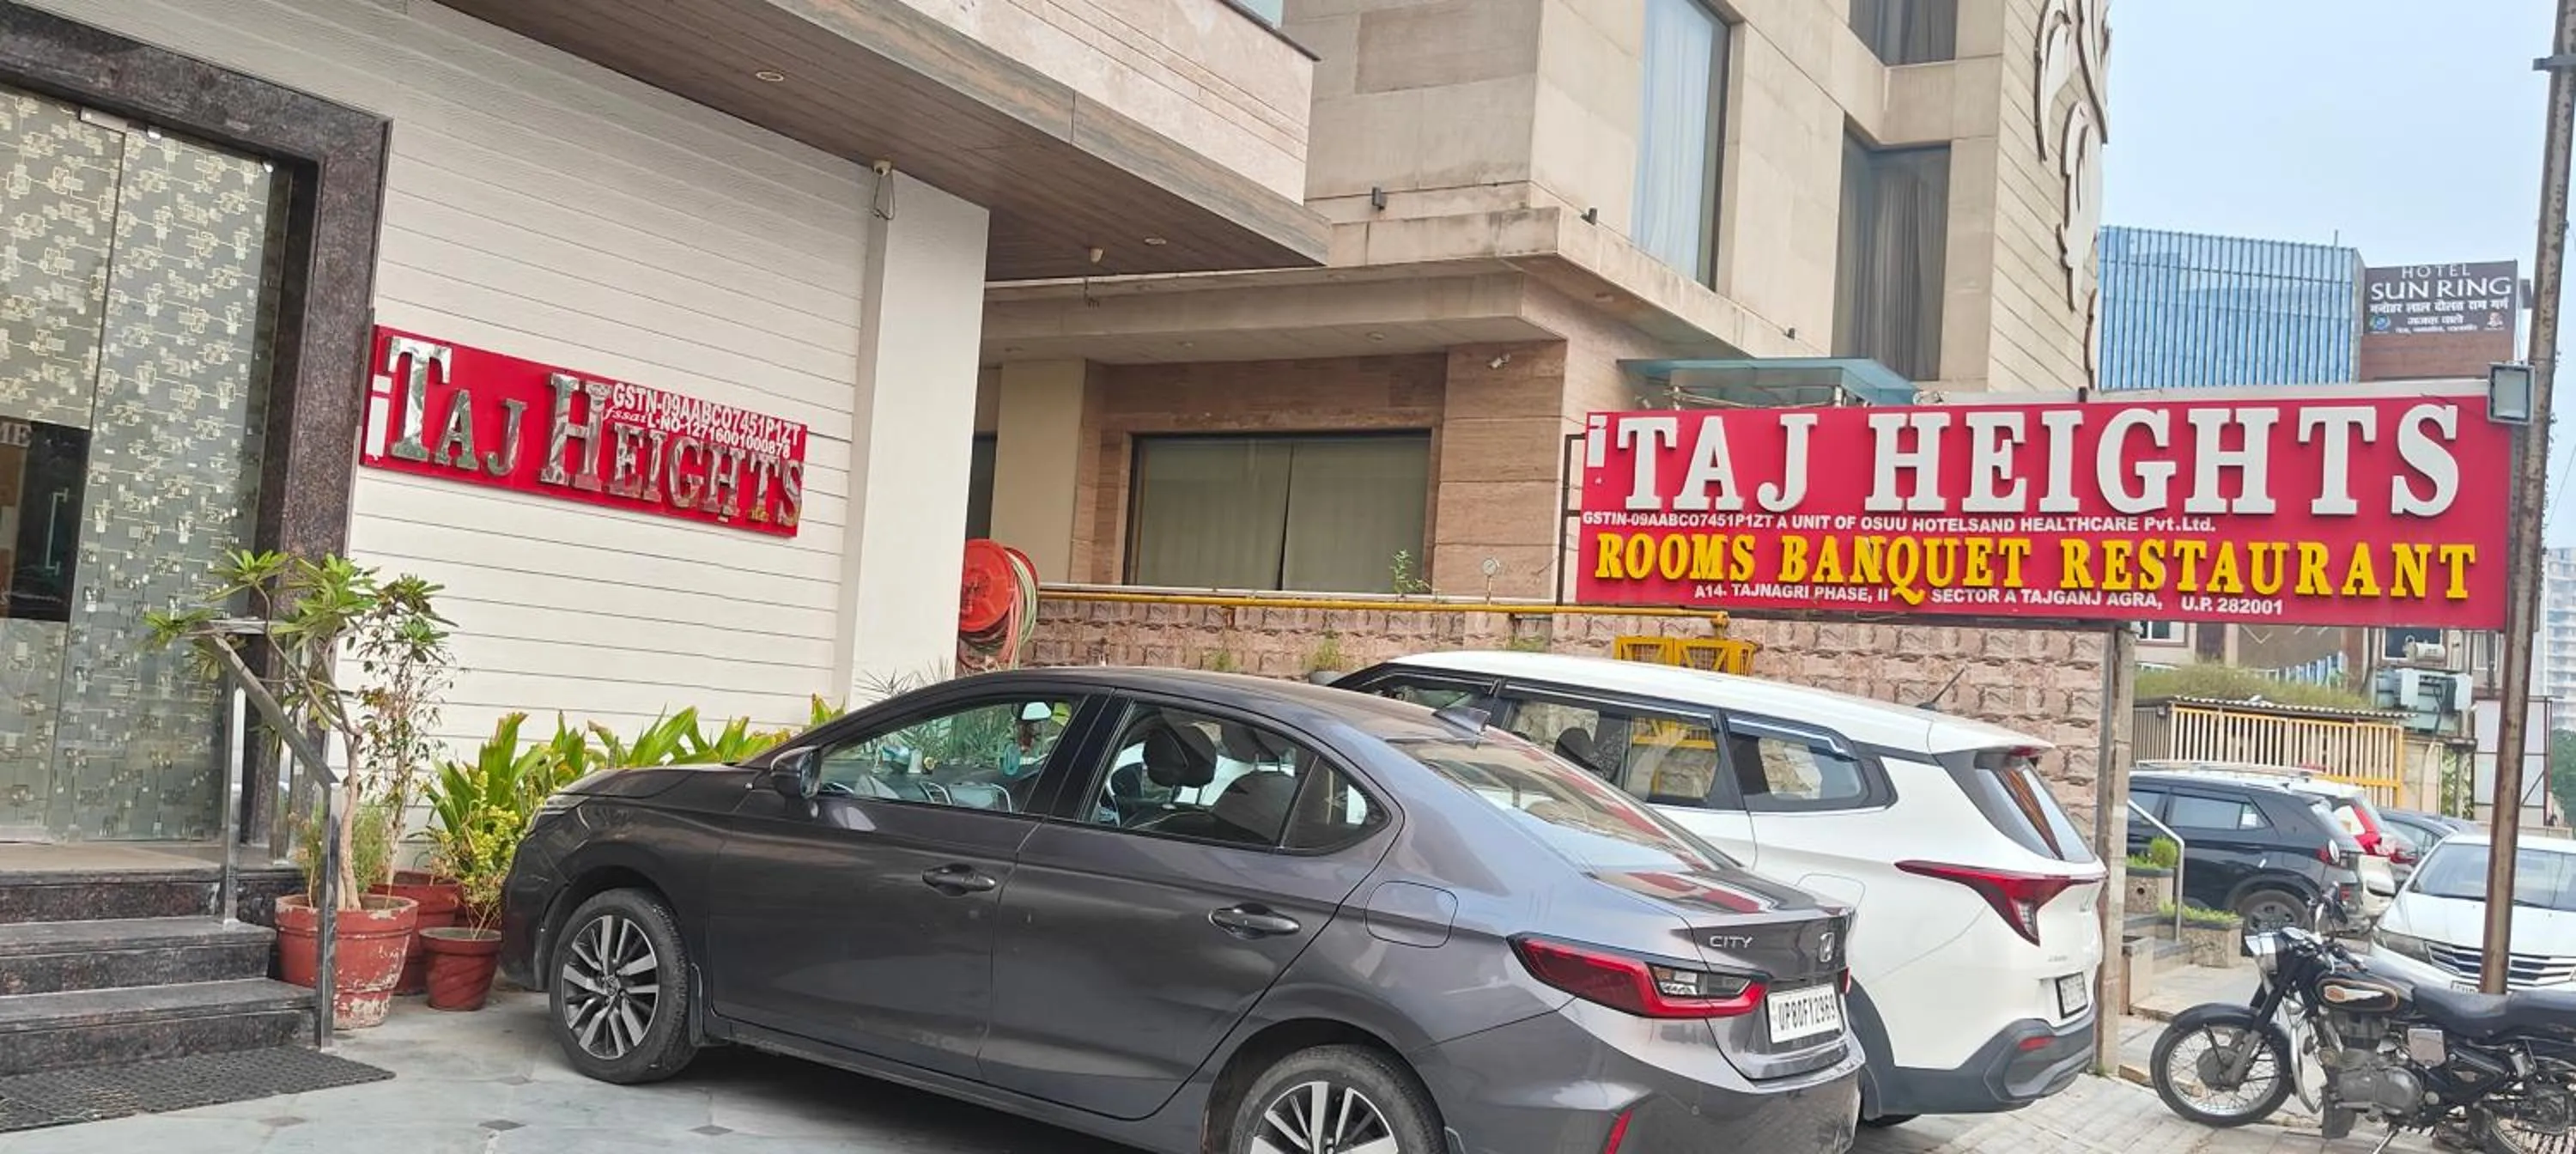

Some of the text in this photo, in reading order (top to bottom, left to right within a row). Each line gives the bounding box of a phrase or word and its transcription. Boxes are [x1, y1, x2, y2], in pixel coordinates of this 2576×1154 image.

[2402, 263, 2470, 279] HOTEL
[2371, 277, 2512, 301] SUN RING
[538, 372, 804, 526] HEIGHTS
[1864, 404, 2460, 517] HEIGHTS
[1776, 515, 1788, 529] A
[1791, 514, 1831, 530] UNIT
[1834, 514, 1857, 530] OF
[1860, 516, 1908, 531] OSUU
[2020, 517, 2139, 532] HEALTHCARE
[1595, 531, 2476, 606] ROOMS BANQUET RESTAURANT
[1731, 583, 1809, 599] TAJNAGRI
[1931, 588, 2000, 604] SECTOR
[2004, 589, 2018, 604] A
[2020, 588, 2102, 607] TAJGANJ
[2217, 598, 2284, 616] 282001
[1710, 935, 1753, 949] CITY
